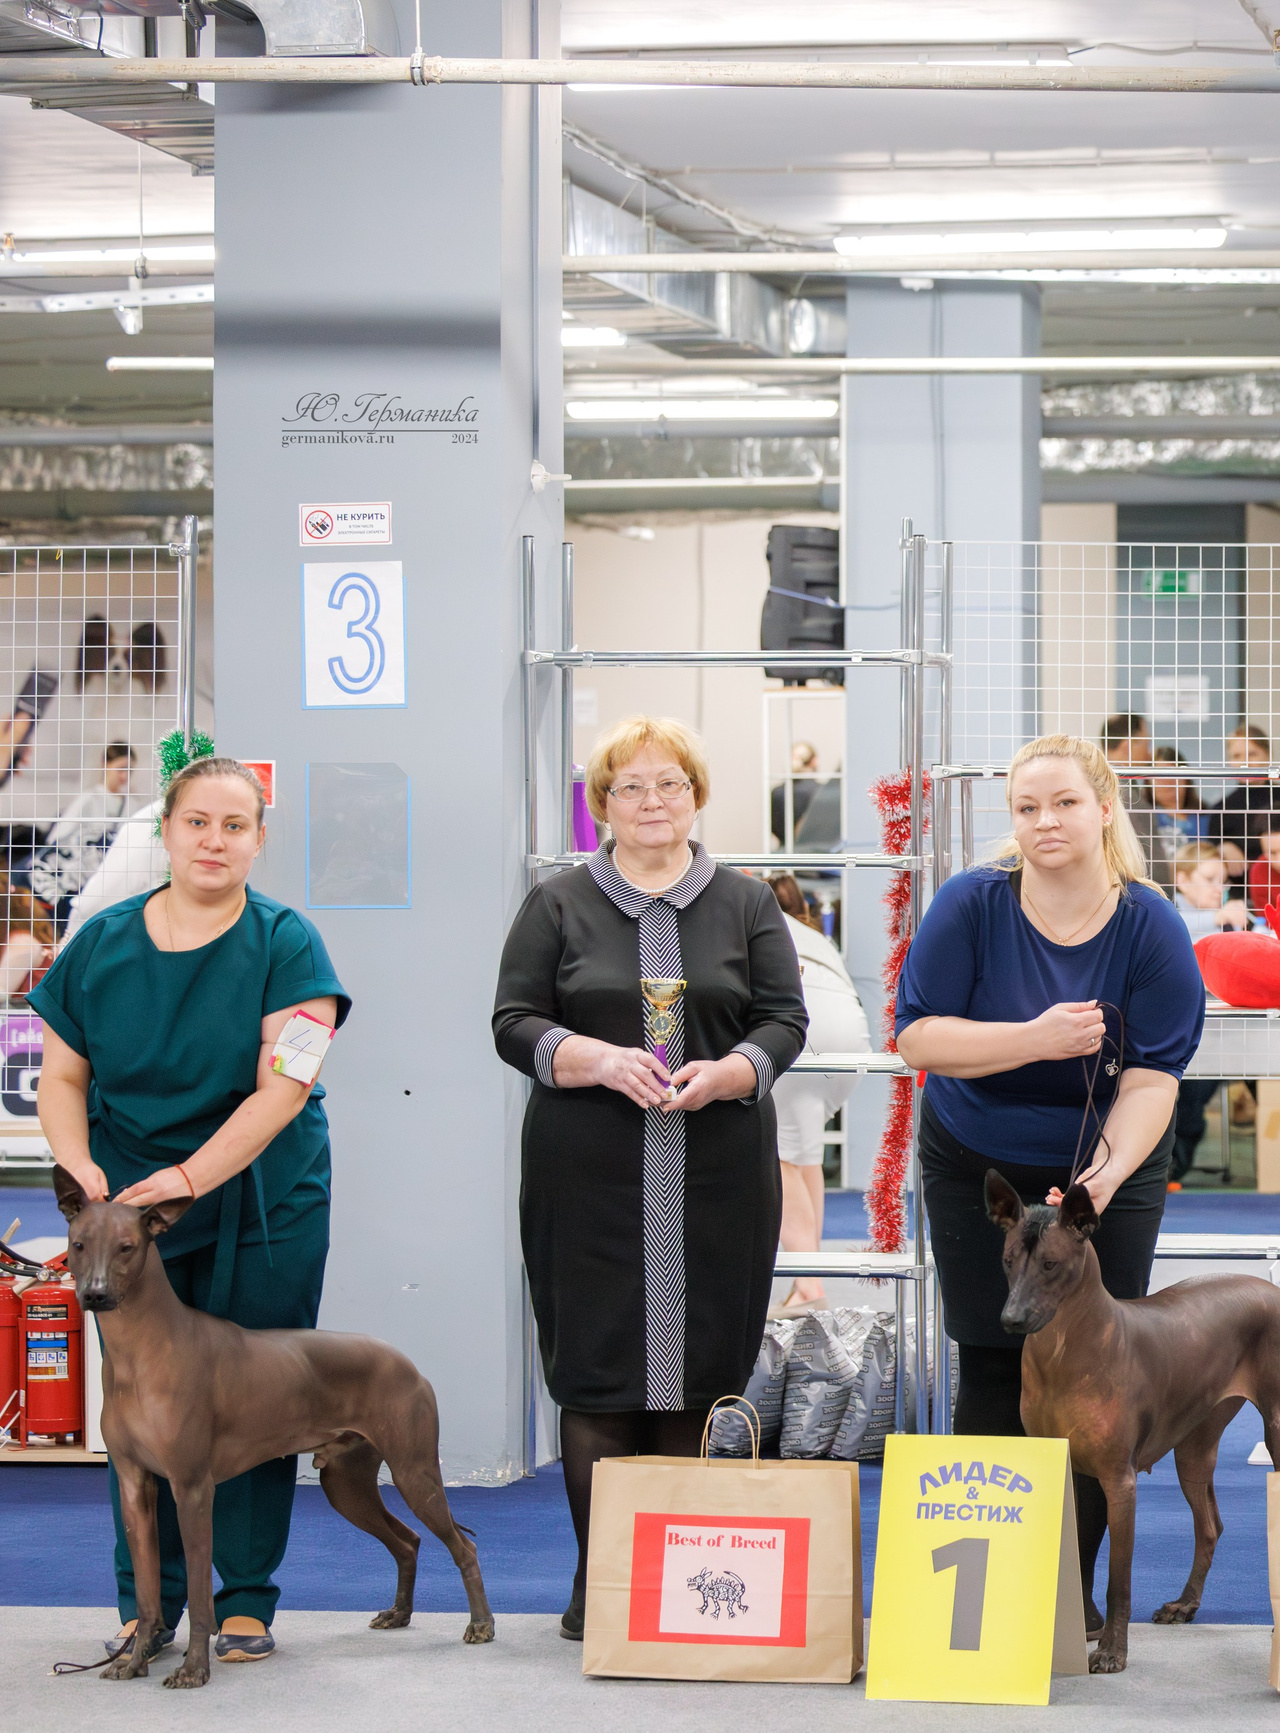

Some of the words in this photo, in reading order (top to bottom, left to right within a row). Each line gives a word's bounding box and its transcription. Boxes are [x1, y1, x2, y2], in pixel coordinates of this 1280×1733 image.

[336, 513, 349, 521] НЕ
[350, 512, 386, 521] КУРИТЬ
[328, 572, 385, 695] 3
[287, 1029, 312, 1065] 4
[919, 1461, 1033, 1497] ЛИДЕР
[966, 1486, 979, 1500] &
[916, 1502, 1024, 1523] ПРЕСТИЖ
[667, 1532, 702, 1547] Best
[706, 1534, 725, 1547] of
[730, 1535, 776, 1549] Breed
[931, 1538, 990, 1651] 1
